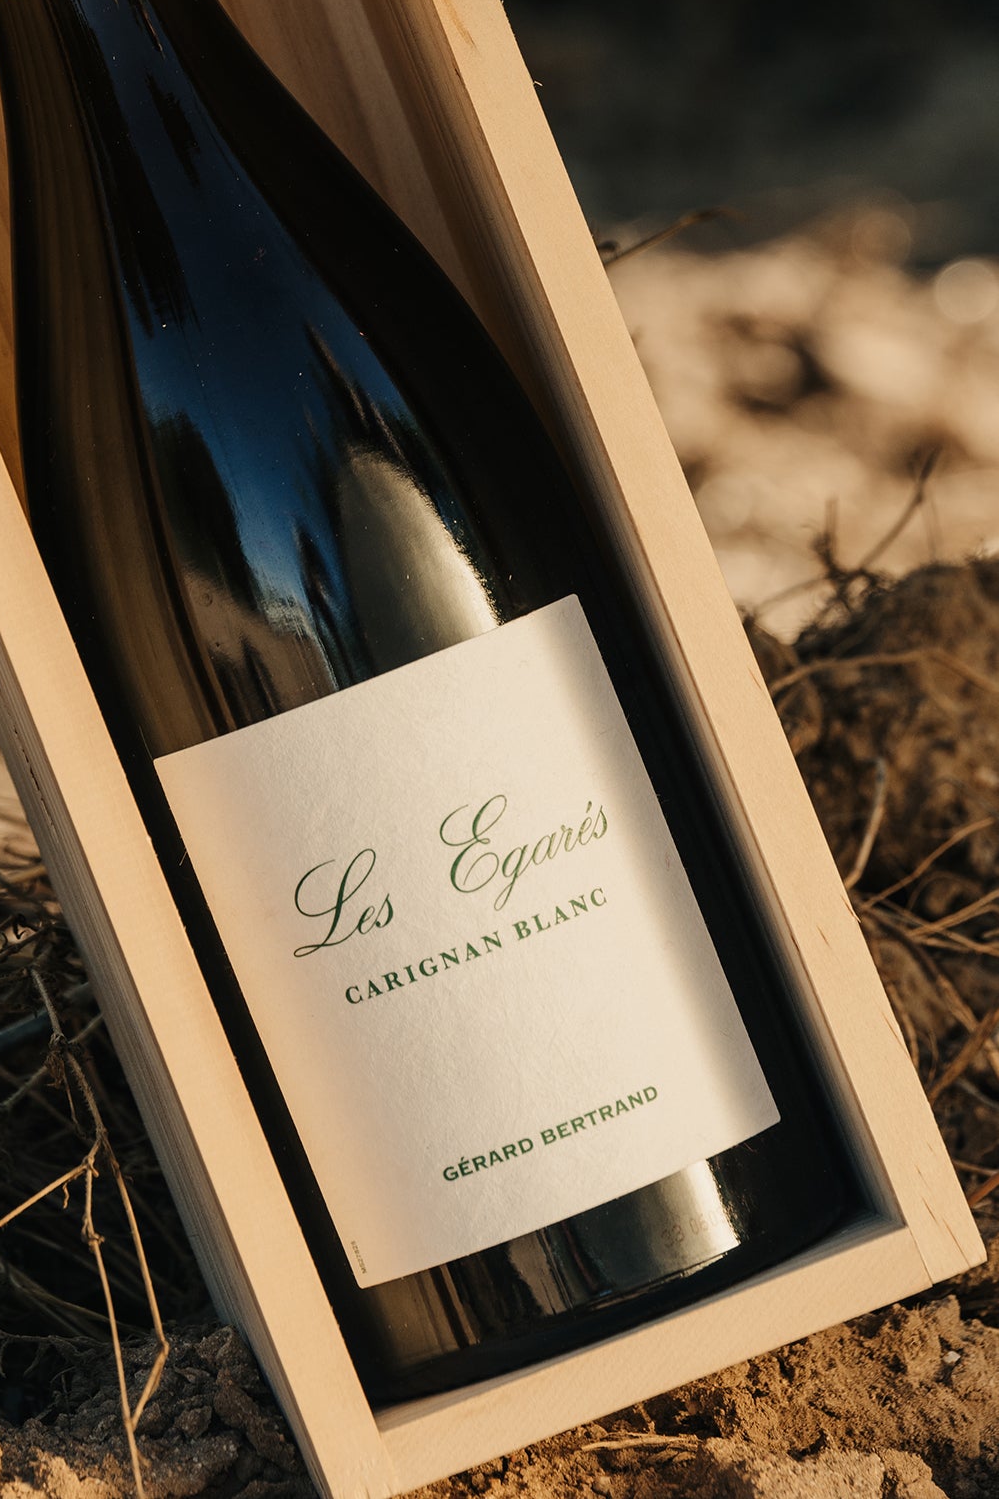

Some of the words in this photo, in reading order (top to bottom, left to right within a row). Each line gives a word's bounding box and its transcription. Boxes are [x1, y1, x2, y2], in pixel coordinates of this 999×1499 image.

[293, 848, 395, 959] Les
[438, 794, 608, 912] Egarés
[344, 930, 503, 1005] CARIGNAN
[511, 887, 608, 941] BLANC
[442, 1137, 535, 1183] GÉRARD
[539, 1085, 658, 1147] BERTRAND
